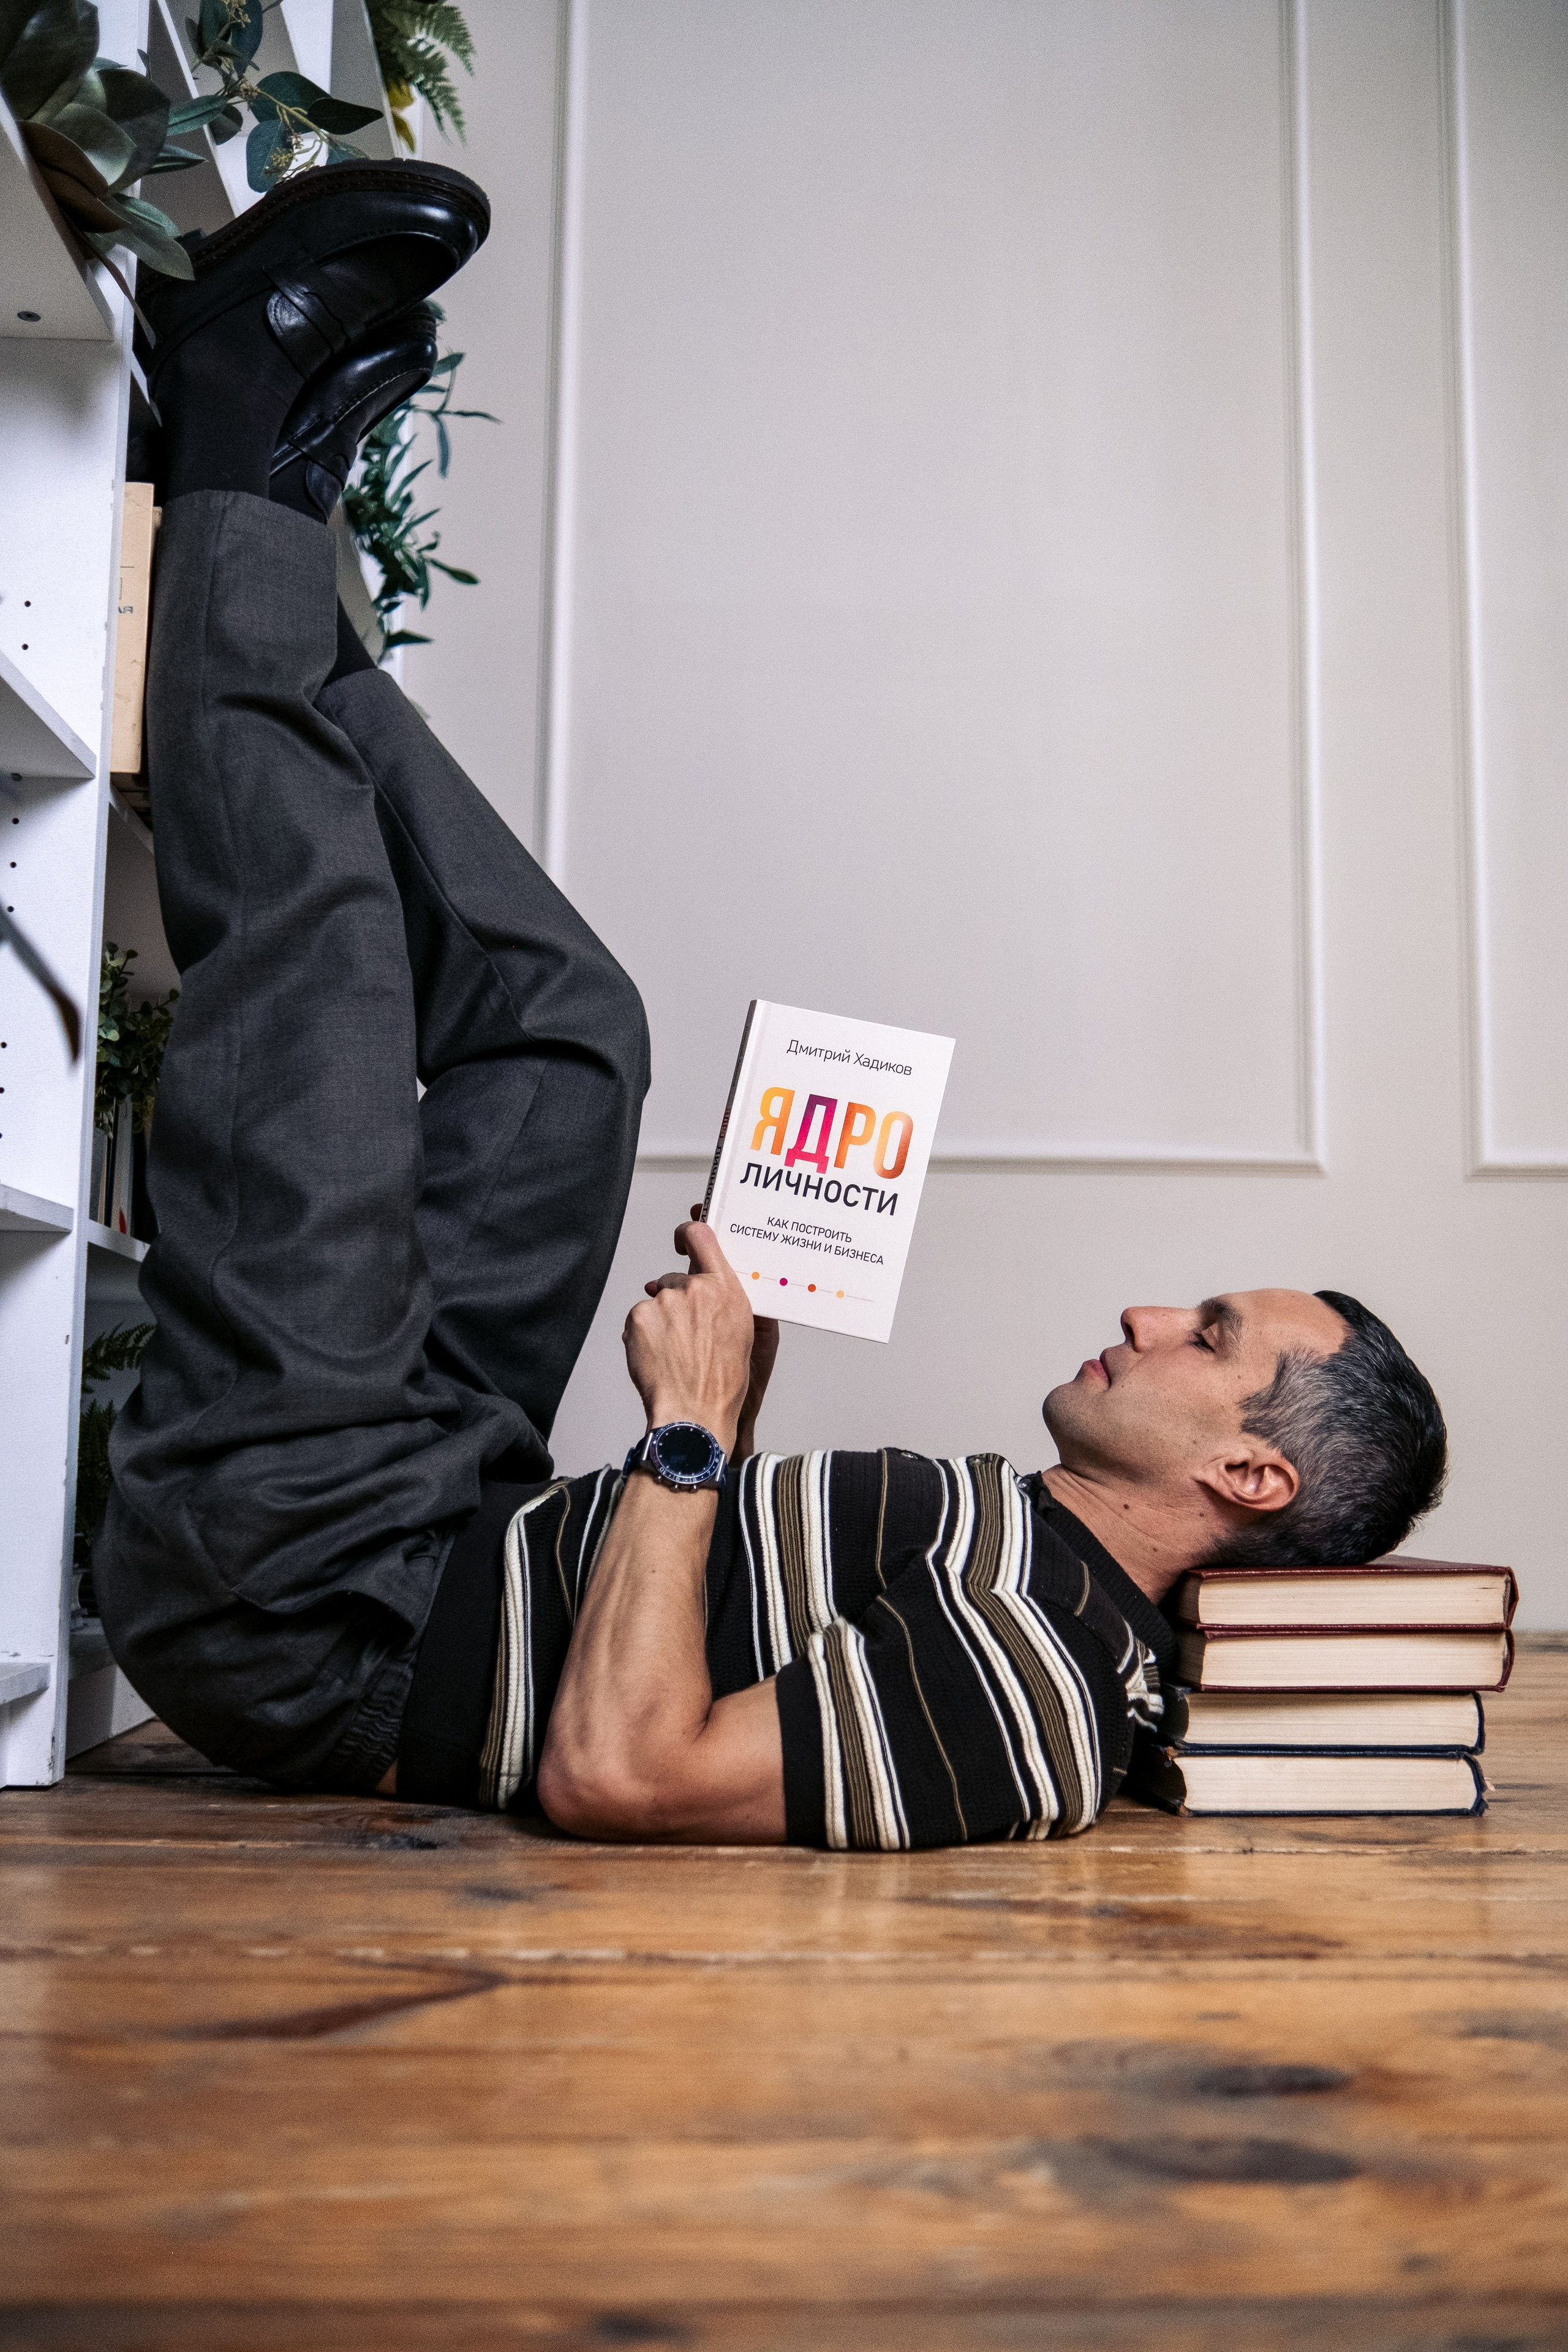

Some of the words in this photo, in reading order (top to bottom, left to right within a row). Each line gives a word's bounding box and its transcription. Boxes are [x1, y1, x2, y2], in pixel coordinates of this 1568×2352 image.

[786, 1039, 851, 1063] Дмитрий
[853, 1052, 913, 1076] Хадиков
[750, 1087, 913, 1179] ЯДРО
[700, 1145, 722, 1223] ЛИЧНОСТИ
[739, 1162, 899, 1216] ЛИЧНОСТИ
[730, 1223, 780, 1242] СИСТЕМУ
[780, 1234, 822, 1251] ЖИЗНИ
[823, 1243, 832, 1254] И
[834, 1245, 883, 1265] БИЗНЕСА
[767, 1216, 790, 1230] КАК
[791, 1221, 852, 1243] ПОСТРОИТЬ
